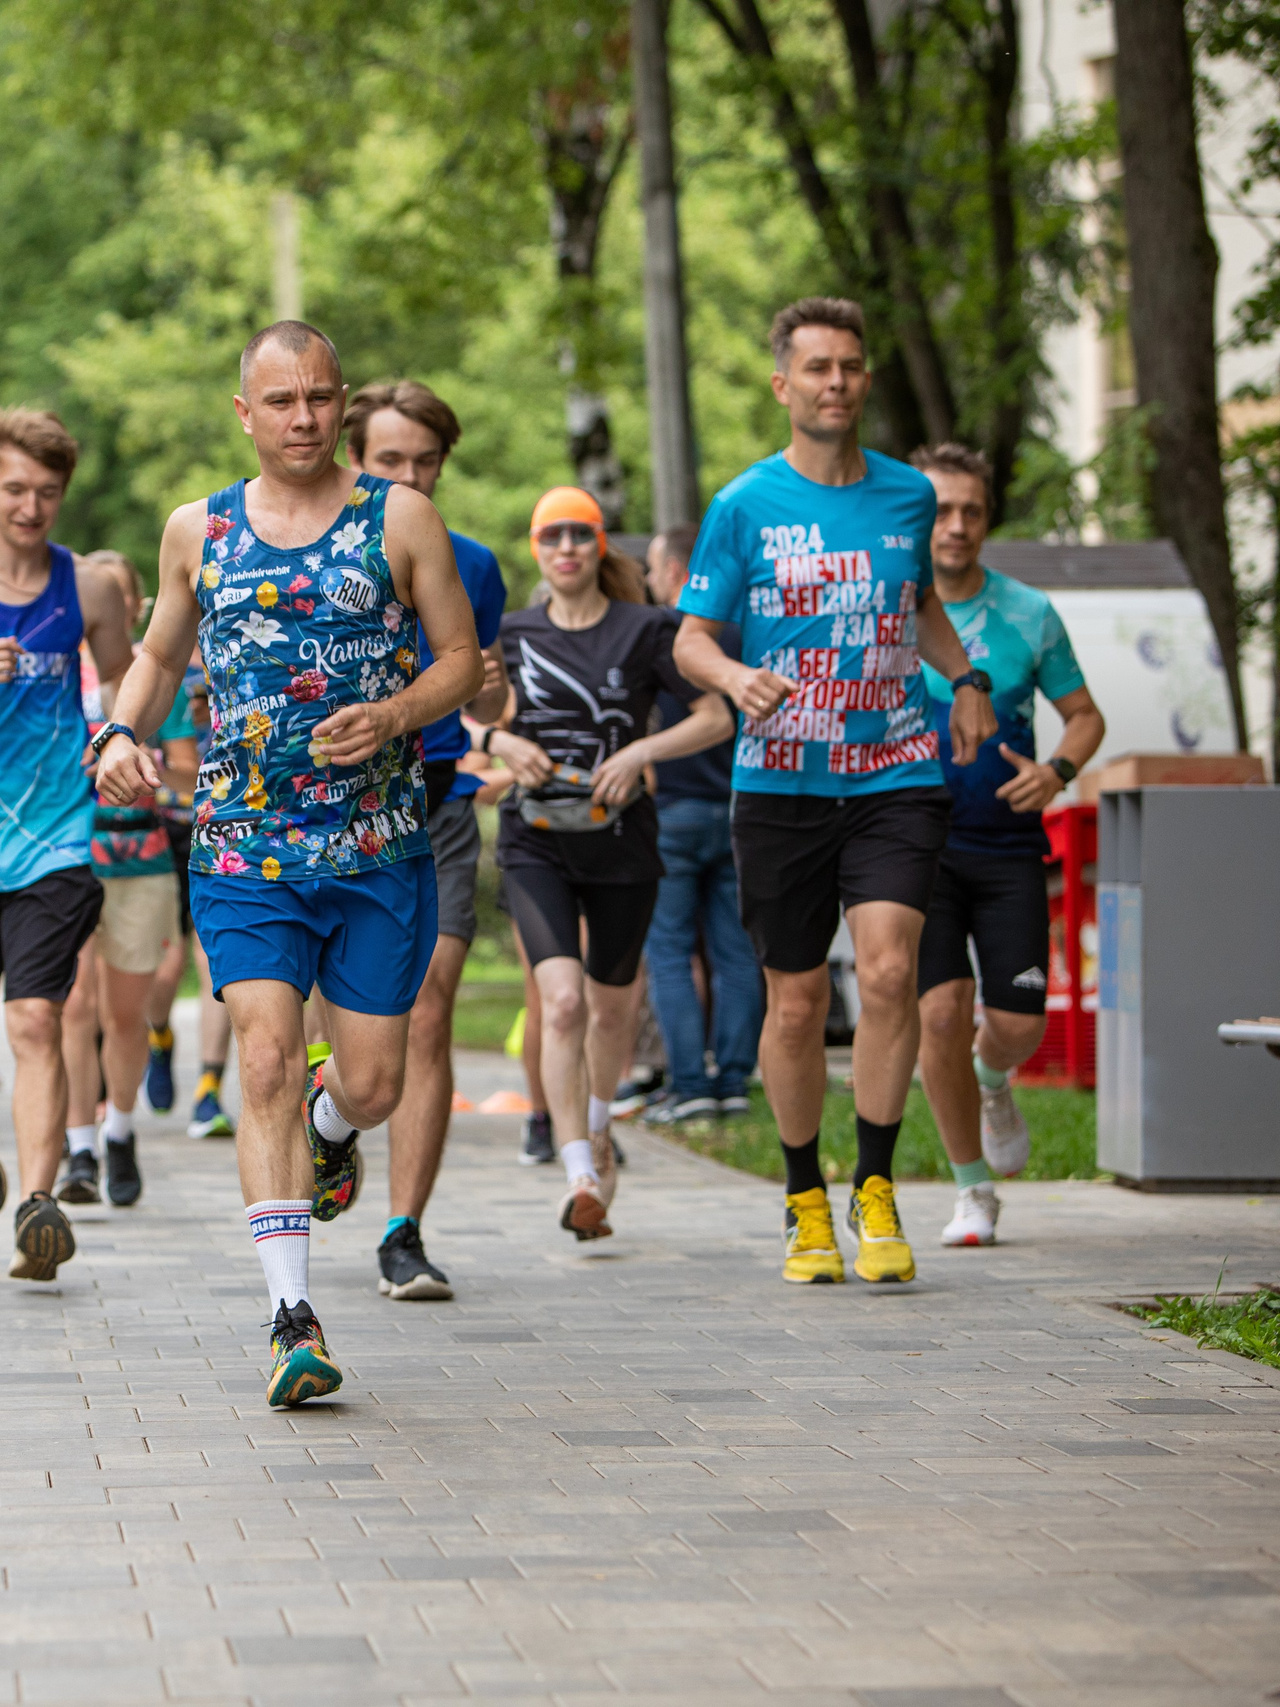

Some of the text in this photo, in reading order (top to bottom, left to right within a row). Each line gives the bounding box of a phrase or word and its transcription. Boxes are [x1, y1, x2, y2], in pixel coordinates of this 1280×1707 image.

[760, 523, 825, 560] 2024
[775, 551, 871, 587] #МЕЧТА
[220, 591, 242, 603] KRB
[331, 574, 371, 612] RAIL
[196, 759, 238, 789] rail
[251, 1218, 284, 1234] RUN
